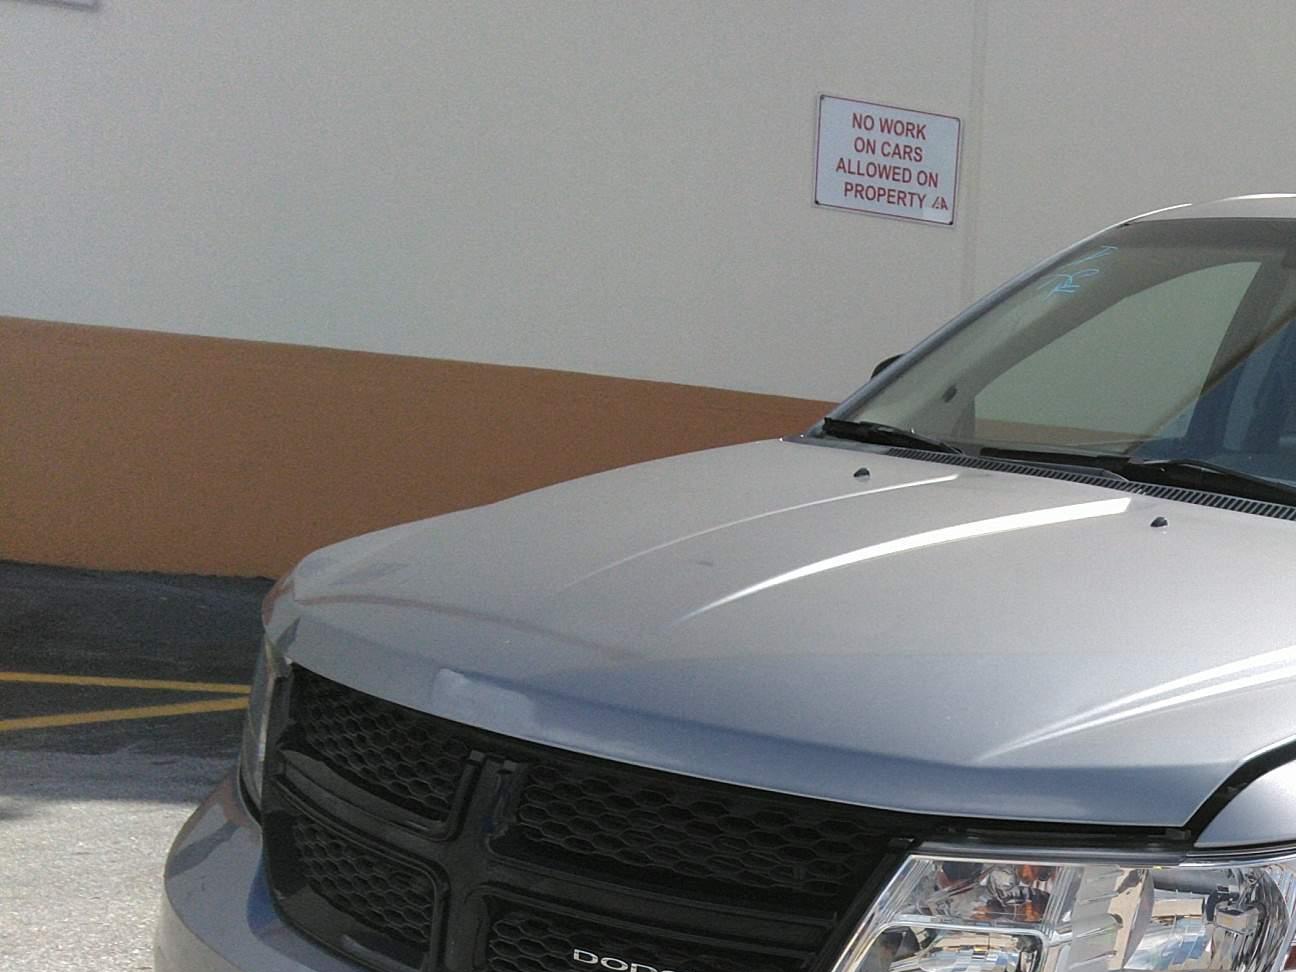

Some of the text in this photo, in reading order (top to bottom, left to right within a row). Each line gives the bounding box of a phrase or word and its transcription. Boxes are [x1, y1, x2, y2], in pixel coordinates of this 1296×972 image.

[852, 112, 927, 140] NO WORK
[854, 136, 924, 162] ON CARS
[835, 157, 939, 189] ALLOWED ON
[843, 181, 927, 209] PROPERTY
